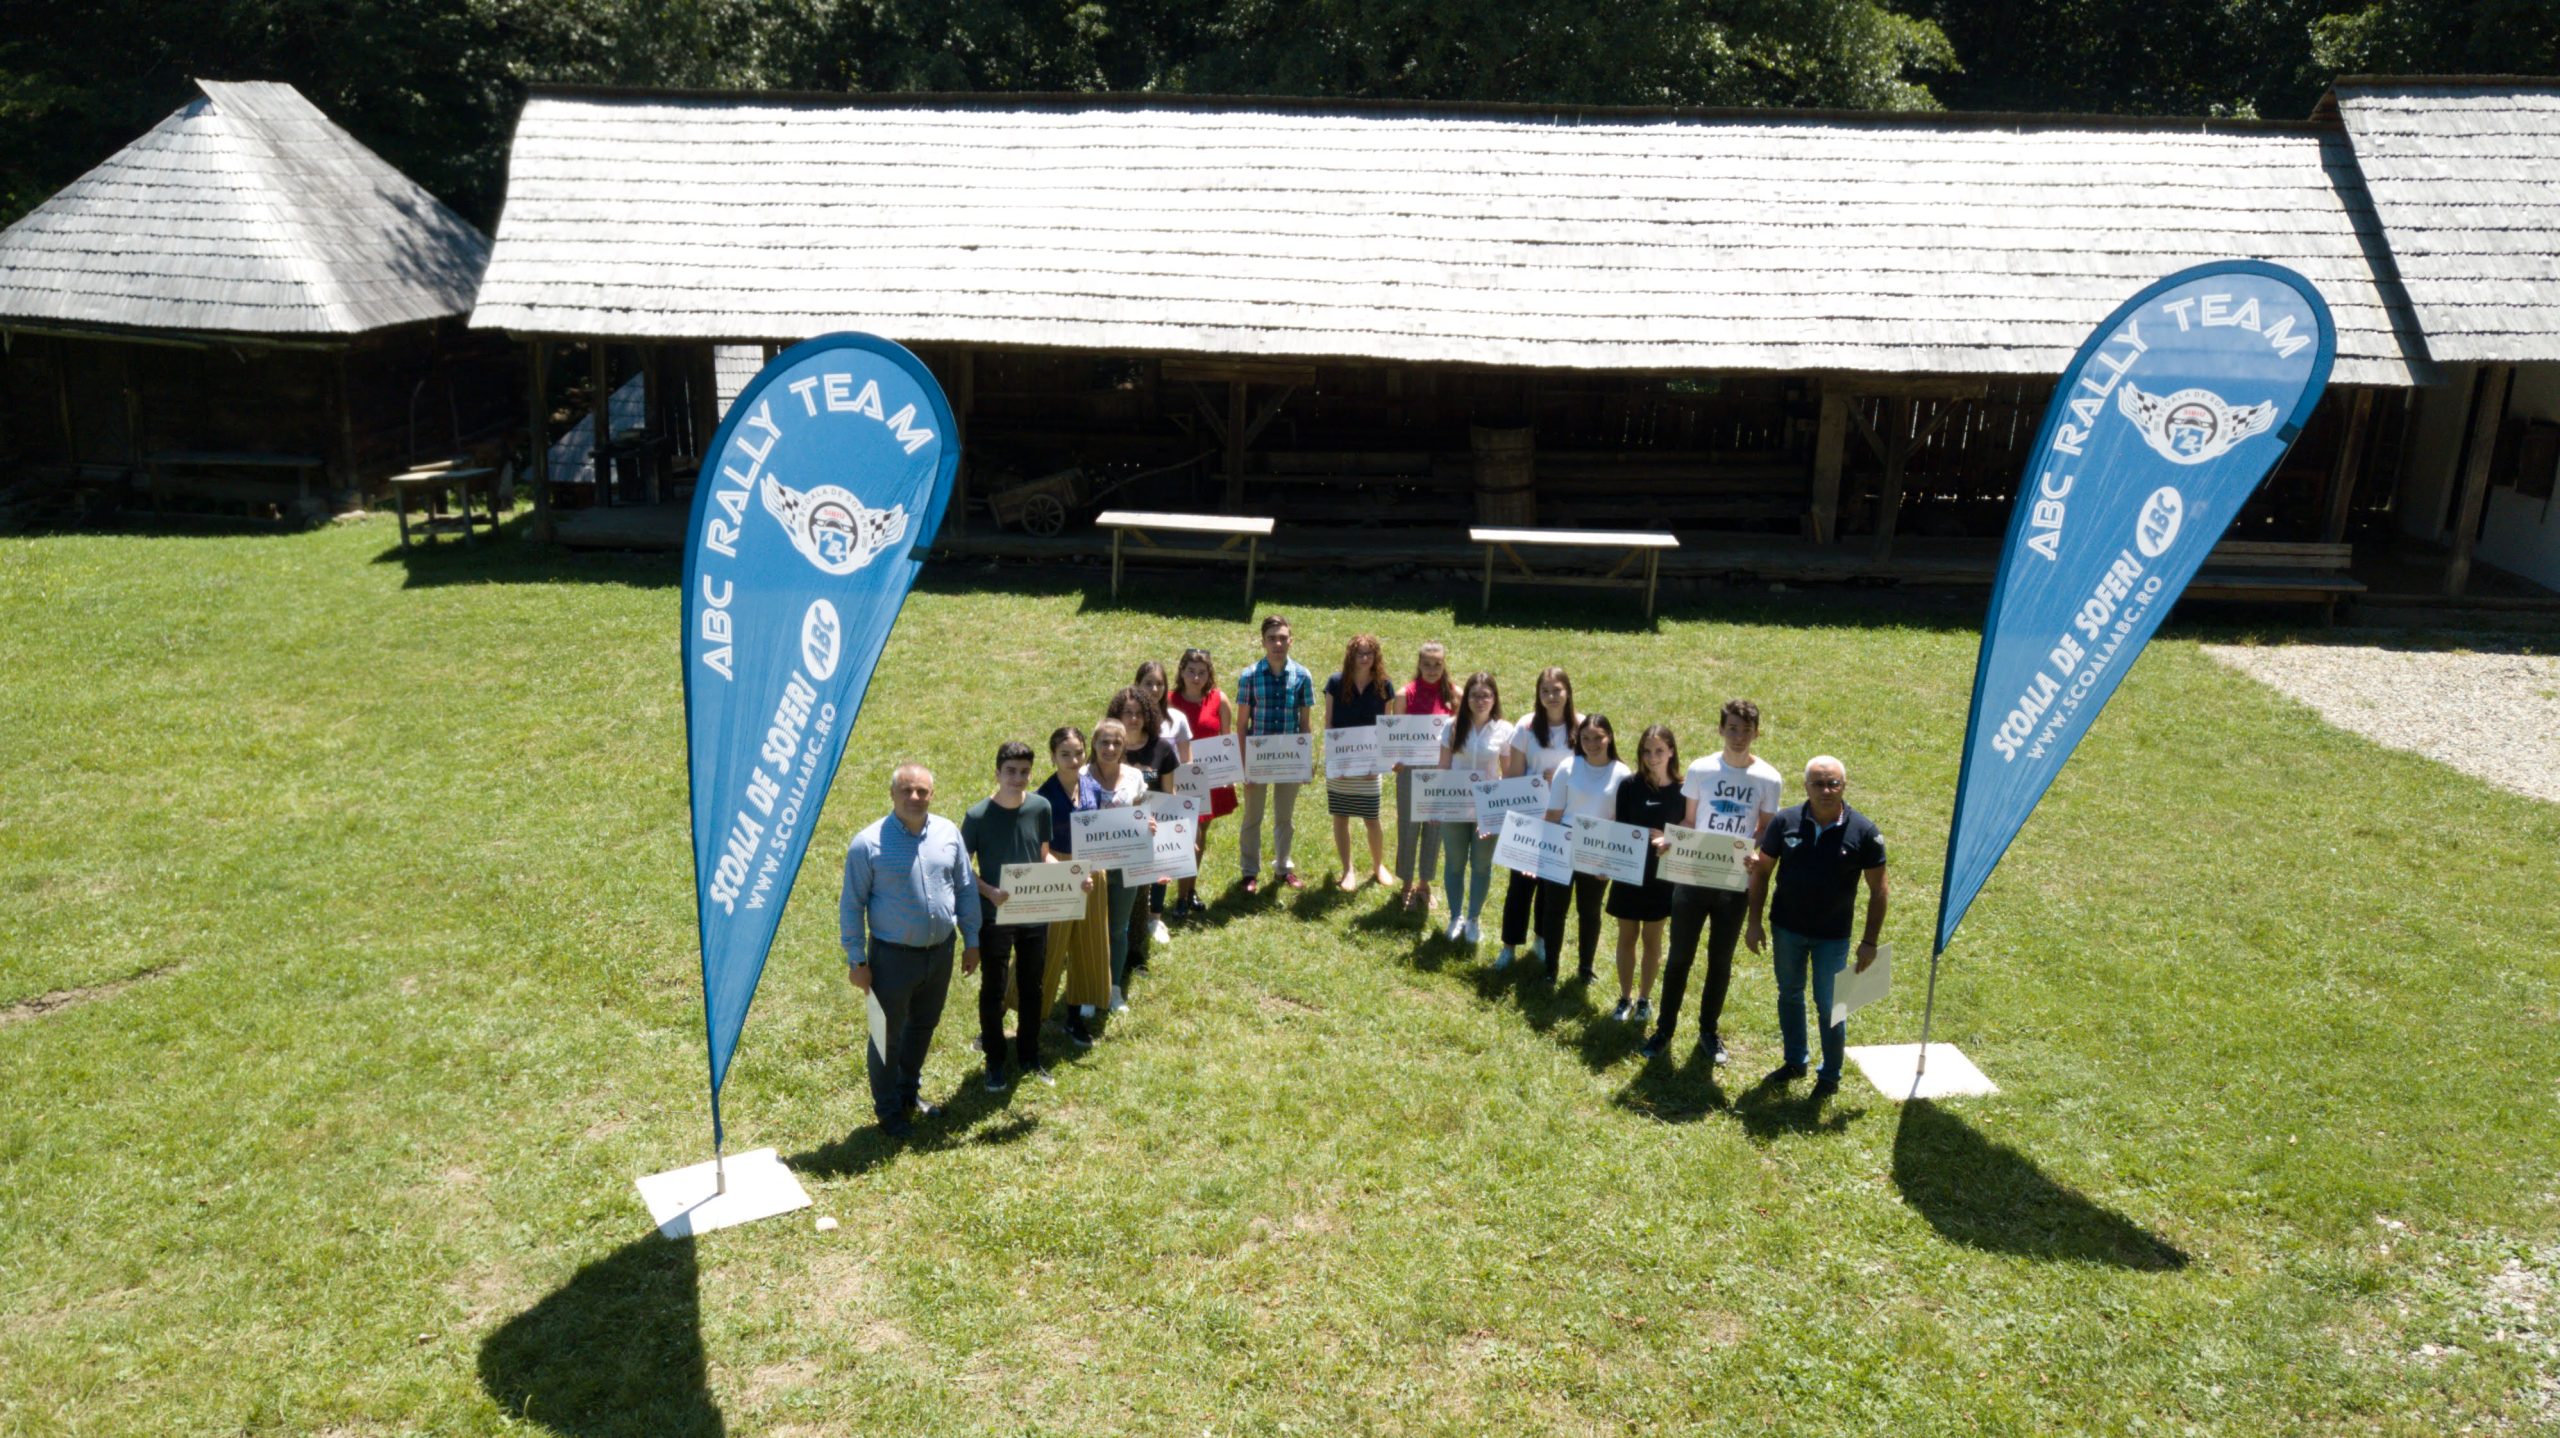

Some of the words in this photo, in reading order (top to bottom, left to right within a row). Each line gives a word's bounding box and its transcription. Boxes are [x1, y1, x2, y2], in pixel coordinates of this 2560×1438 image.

[788, 373, 935, 455] TEAM
[2028, 471, 2074, 561] ABC
[2053, 319, 2148, 456] RALLY
[2163, 293, 2311, 360] TEAM
[706, 399, 782, 558] RALLY
[701, 574, 734, 682] ABC
[806, 606, 836, 675] ABC
[1991, 671, 2062, 763] SCOALA
[2049, 632, 2086, 677] DE
[2073, 549, 2144, 642] SOFERI
[2141, 492, 2177, 550] ABC
[2025, 575, 2163, 760] WWW.SCOALAABC.RO
[762, 670, 817, 776] SOFERI
[1389, 733, 1437, 742] DIPLOMA
[1256, 750, 1301, 761] DIPLOMA
[745, 766, 781, 817] DE
[745, 703, 837, 910] WWW.SCOALAABC.RO
[1424, 787, 1473, 797] DIPLOMA
[1488, 795, 1538, 809] DIPLOMA
[710, 810, 765, 917] SCOALA
[1086, 829, 1140, 842] DIPLOMA
[1513, 834, 1564, 856] DIPLOMA
[1583, 836, 1634, 856] DIPLOMA
[1676, 847, 1736, 864] DIPLOMA
[1014, 882, 1073, 895] DIPLOMA
